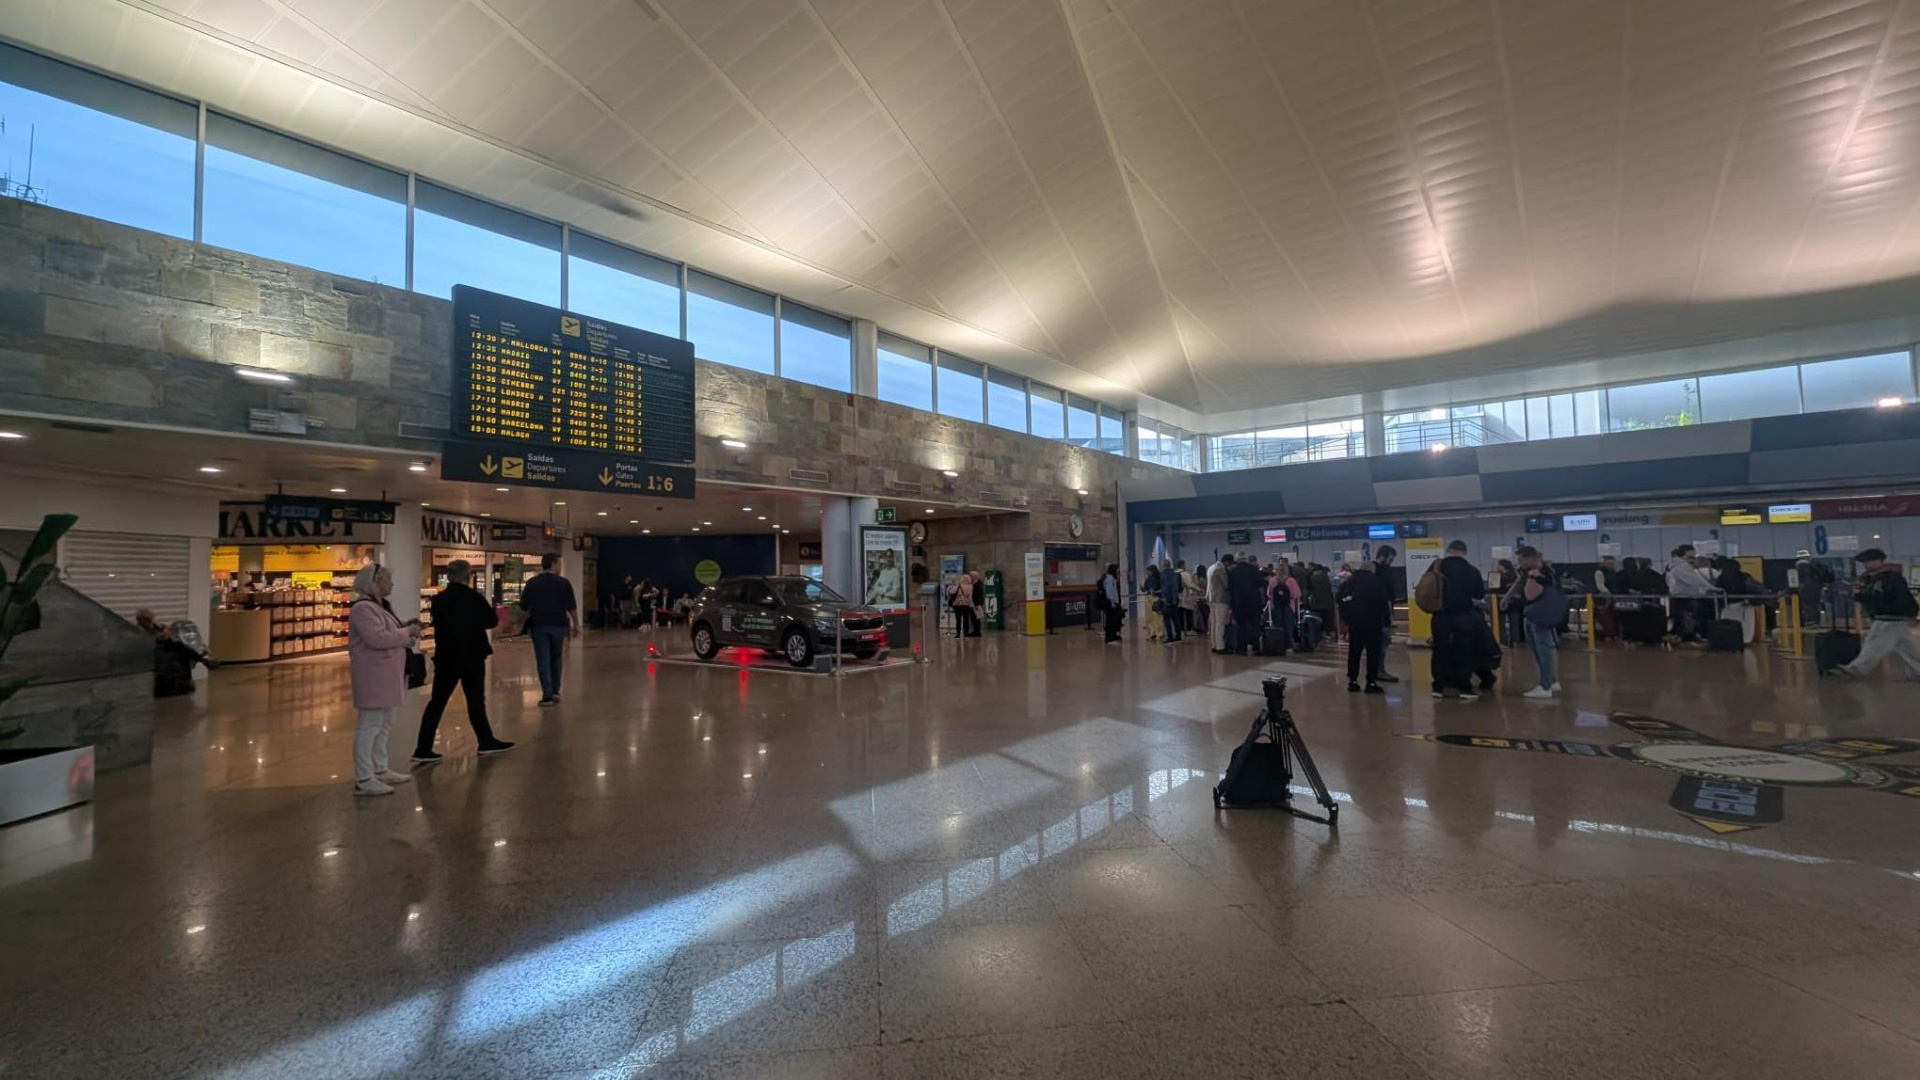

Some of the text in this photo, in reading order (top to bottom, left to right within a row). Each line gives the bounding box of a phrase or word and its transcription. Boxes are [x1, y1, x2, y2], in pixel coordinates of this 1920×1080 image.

[471, 331, 496, 342] 12:30
[501, 348, 530, 359] MADRID
[471, 352, 496, 363] 13:40
[501, 358, 530, 369] MADRID
[501, 368, 544, 381] BARCELONA
[501, 388, 534, 399] LONDRES
[471, 394, 496, 404] 17:10
[501, 399, 530, 409] MADRID
[471, 404, 496, 414] 17:45
[501, 409, 530, 419] MADRID
[501, 419, 544, 430] BARCELONA
[501, 429, 530, 439] MALAGA
[527, 462, 566, 474] Departures
[616, 463, 638, 472] Portas
[527, 472, 556, 482] Salidas
[616, 472, 633, 480] Gates
[616, 480, 641, 489] Puertas
[1838, 504, 1888, 513] IBERIA
[1602, 514, 1650, 524] vueling
[421, 514, 486, 546] MARKET
[1815, 525, 1828, 555] 8
